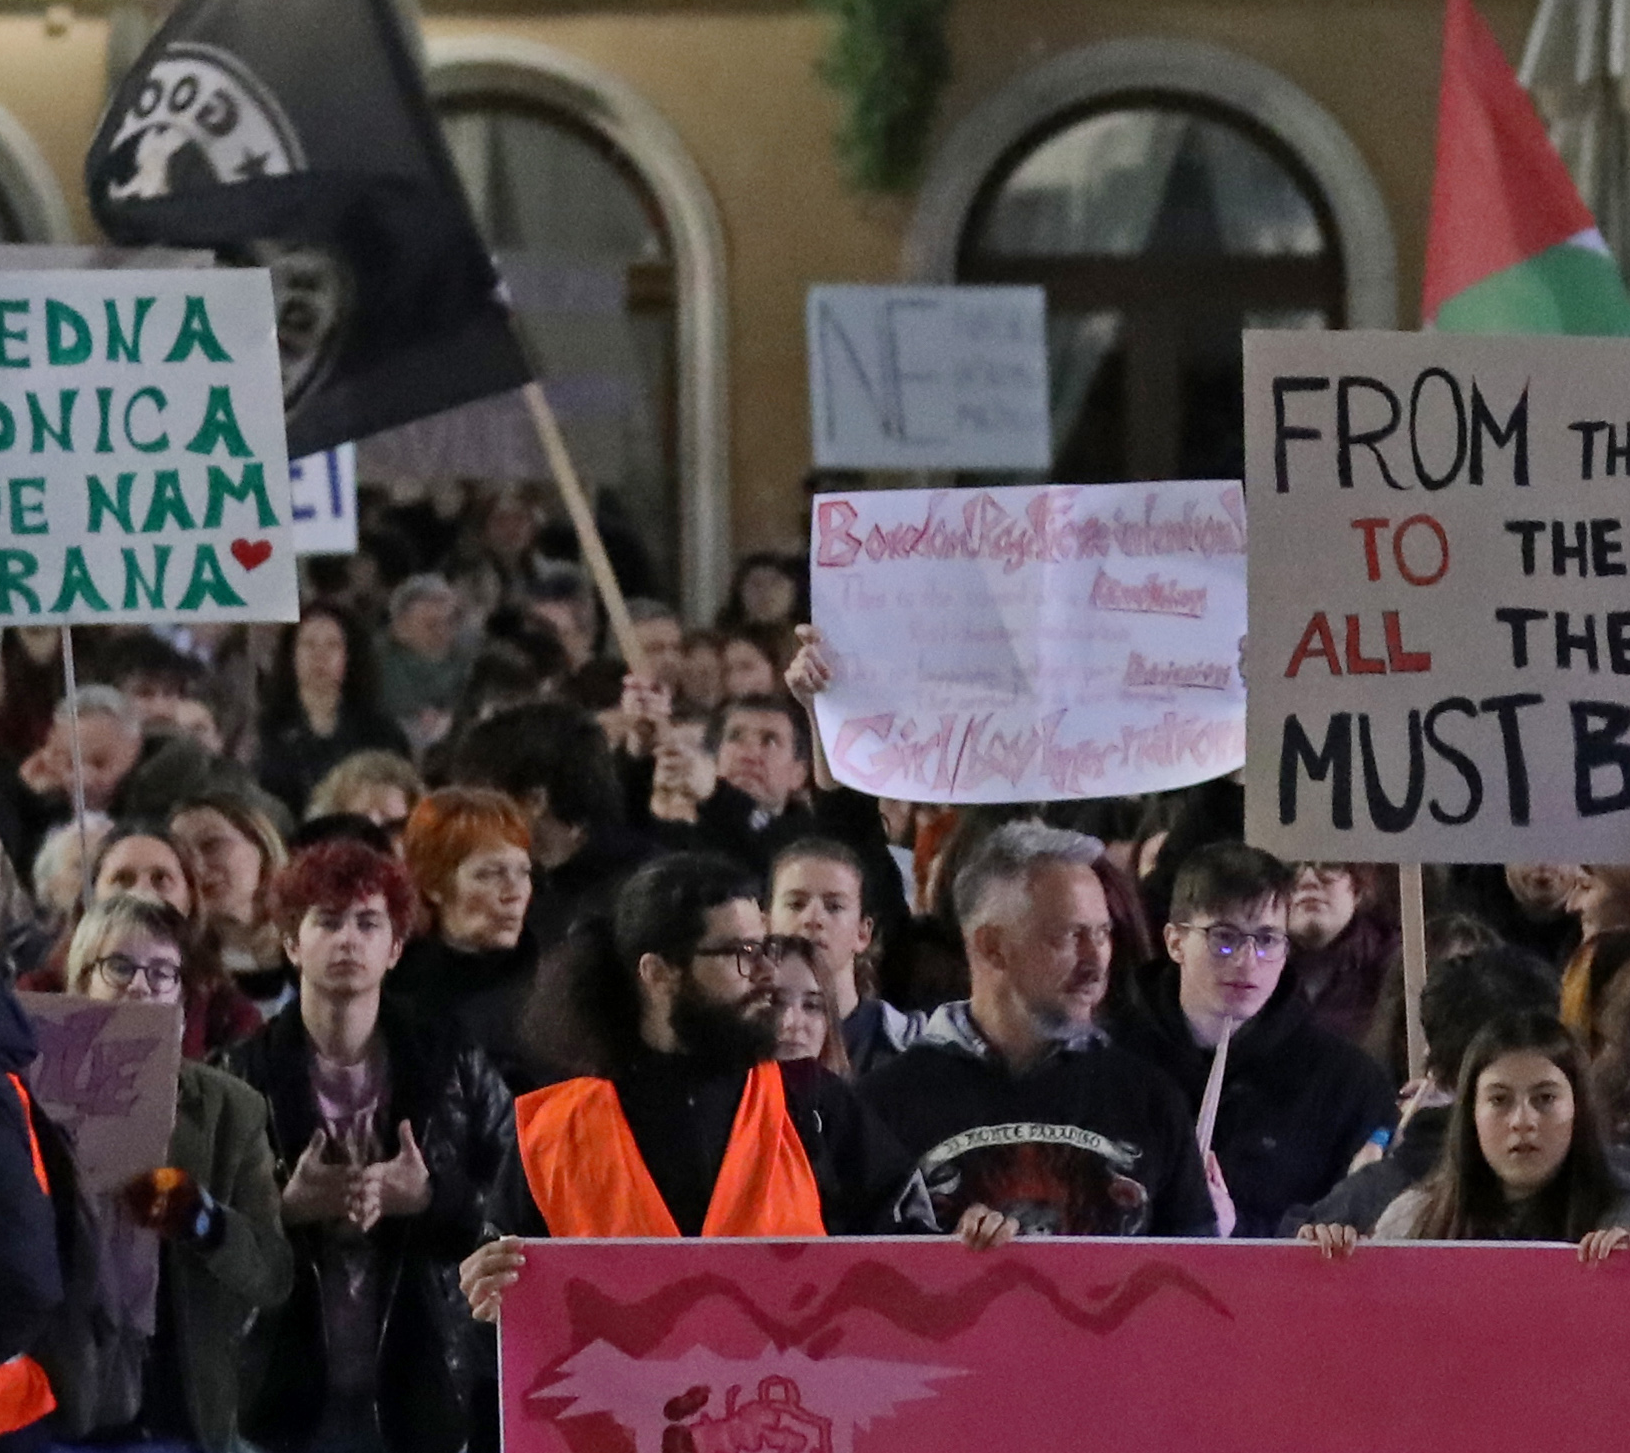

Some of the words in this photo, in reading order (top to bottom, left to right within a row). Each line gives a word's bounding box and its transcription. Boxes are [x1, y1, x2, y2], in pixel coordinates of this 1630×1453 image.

[1272, 366, 1530, 494] FROM
[86, 462, 281, 534] NAM
[1351, 513, 1449, 587] TO
[1504, 518, 1627, 578] THE
[1284, 609, 1433, 678] ALL
[1279, 692, 1544, 834] MUST
